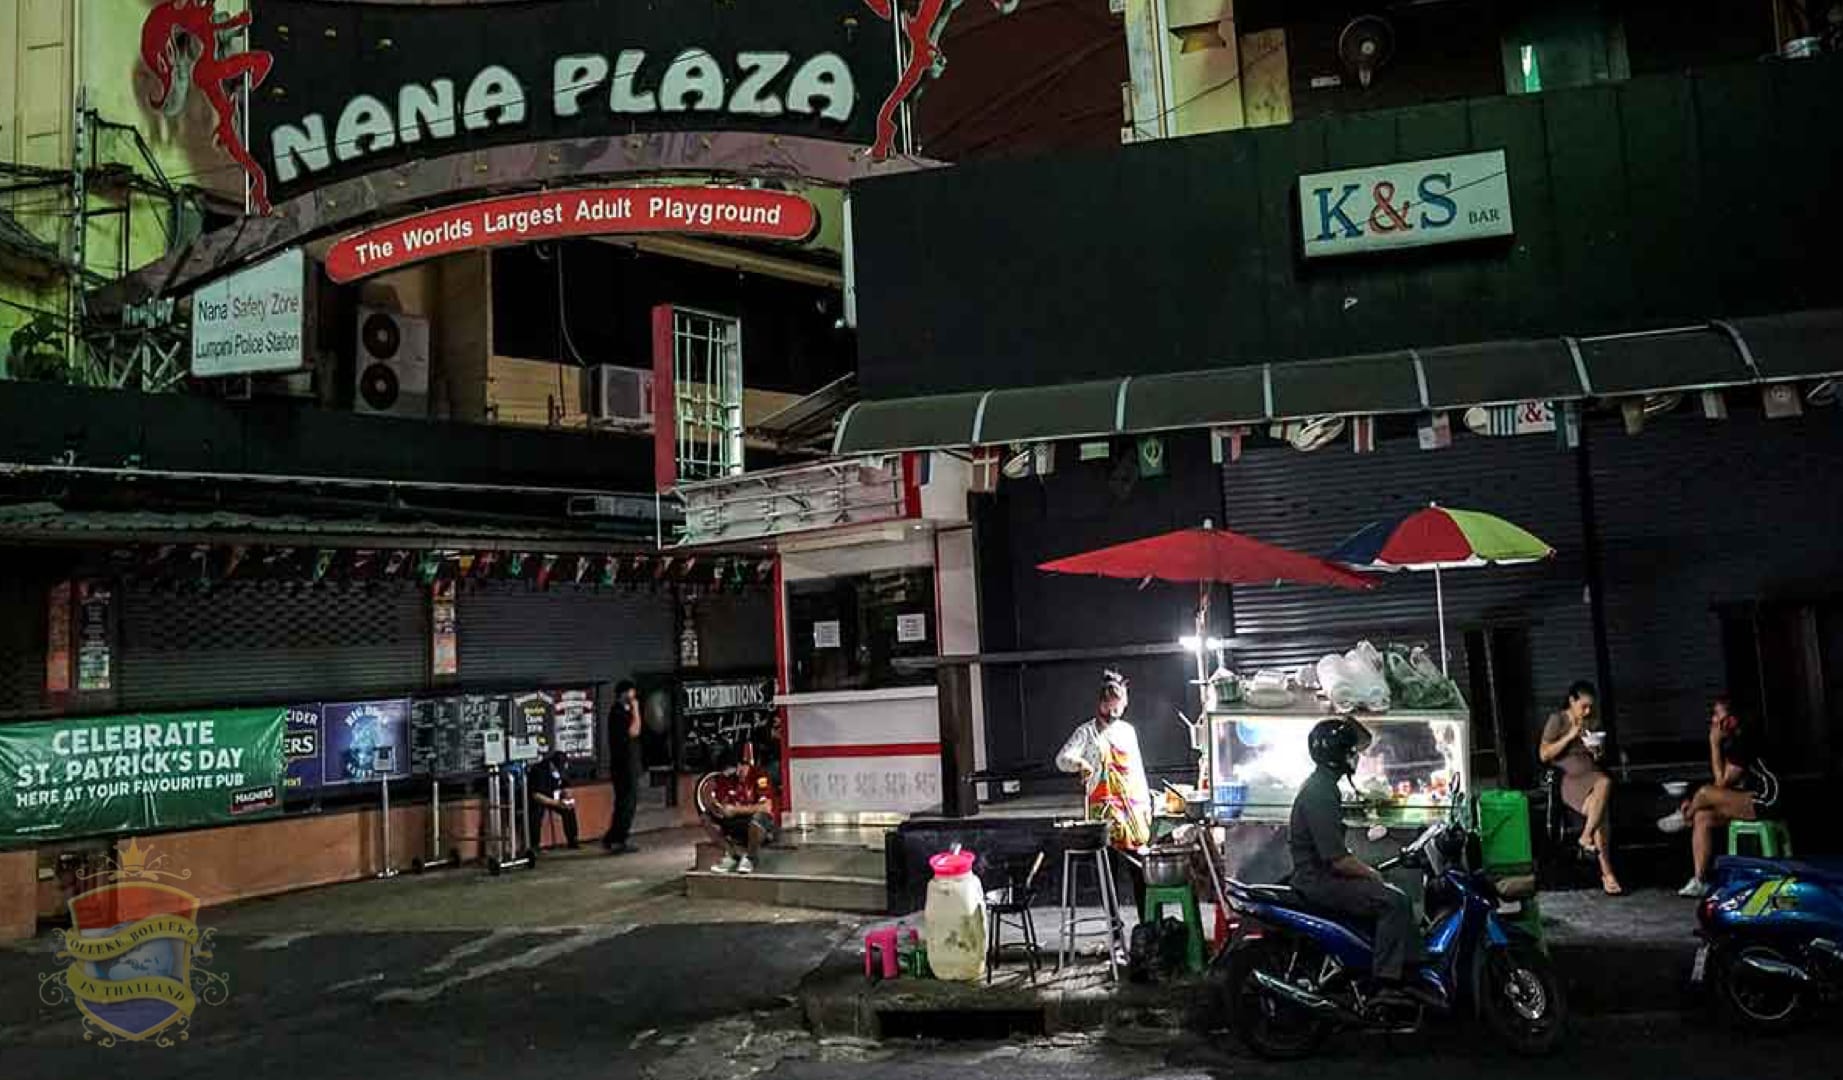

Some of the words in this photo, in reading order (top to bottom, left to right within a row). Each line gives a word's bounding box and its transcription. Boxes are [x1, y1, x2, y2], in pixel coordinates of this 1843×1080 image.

[270, 65, 526, 183] NANA
[553, 46, 855, 122] PLAZA
[1312, 172, 1457, 241] K&S
[1468, 209, 1501, 225] BAR
[355, 238, 394, 266] The
[402, 219, 474, 253] Worlds
[484, 203, 563, 234] Largest
[575, 198, 632, 221] Adult
[648, 197, 782, 226] Playground
[198, 300, 228, 322] Nana
[232, 297, 267, 322] Safety
[270, 293, 298, 315] Zone
[196, 339, 233, 361] Lumpini
[235, 334, 263, 356] Police
[265, 331, 299, 352] Station
[53, 720, 214, 755] CELEBRATE
[17, 763, 57, 788] ST.
[66, 751, 193, 782] PATRICK'S
[199, 747, 244, 770] DAY
[15, 789, 59, 808] HERE
[64, 784, 84, 804] AT
[87, 782, 129, 799] YOUR
[133, 775, 212, 794] FAVOURITE
[215, 773, 245, 787] PUB
